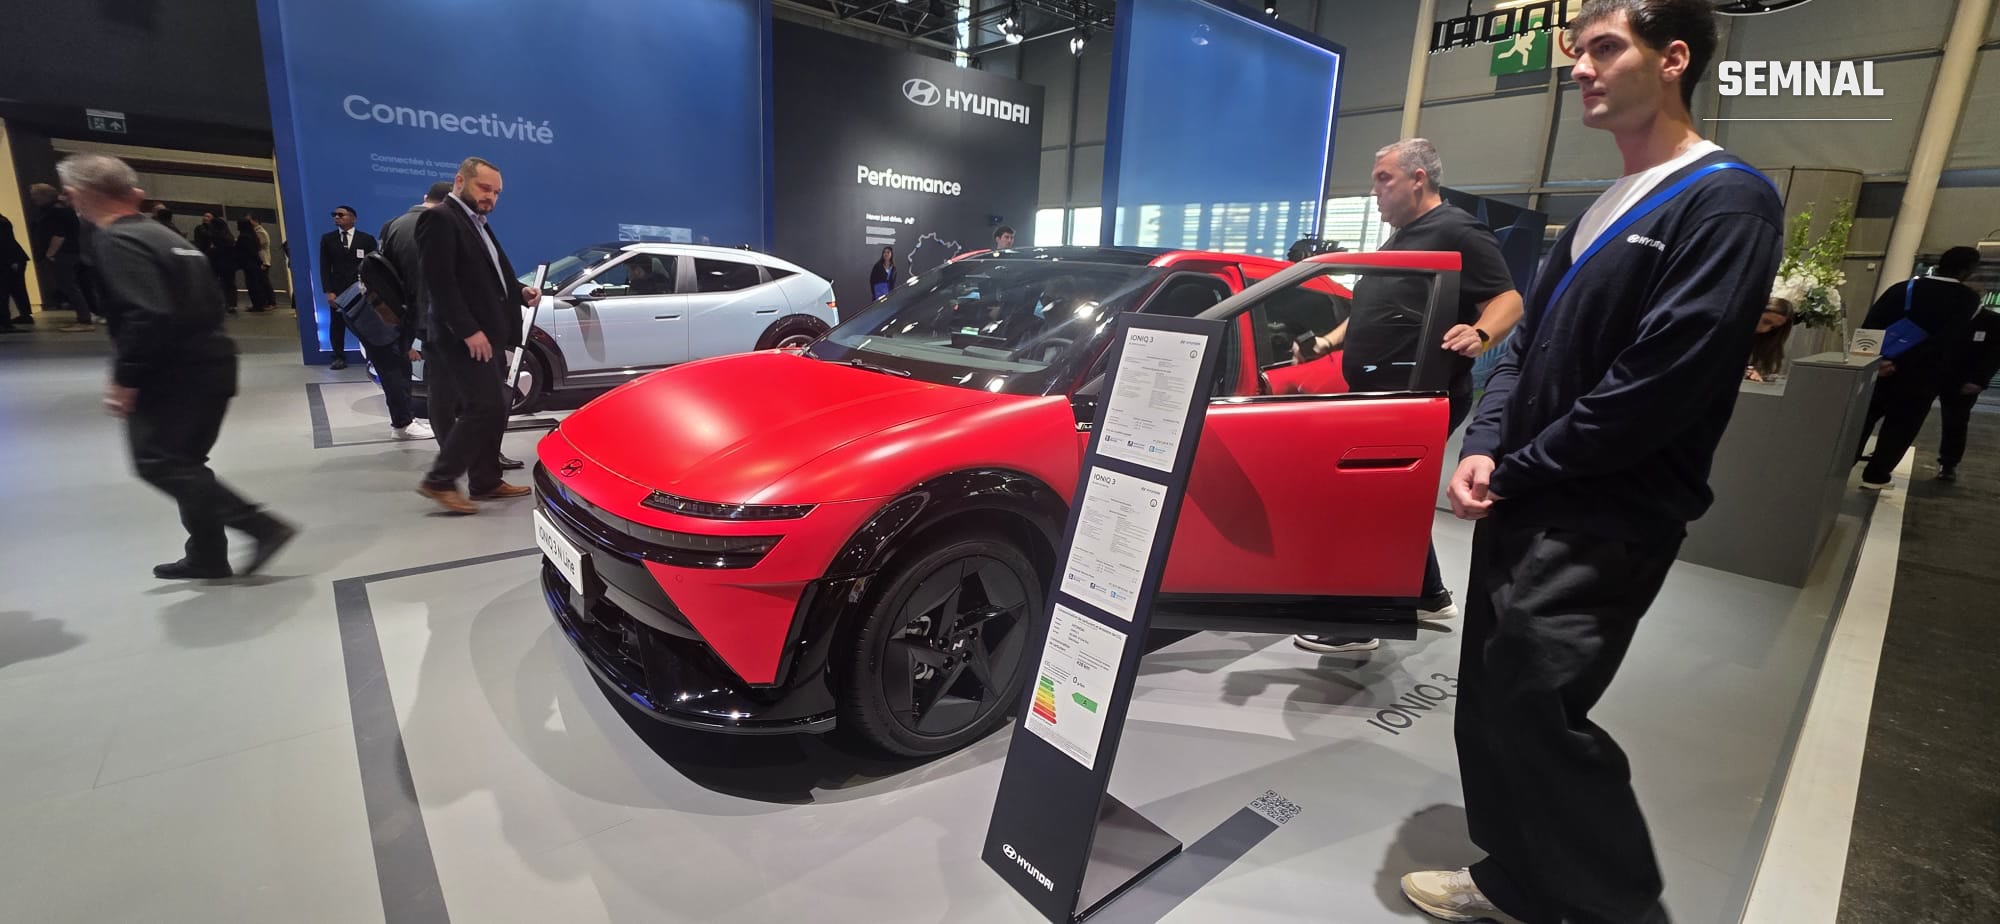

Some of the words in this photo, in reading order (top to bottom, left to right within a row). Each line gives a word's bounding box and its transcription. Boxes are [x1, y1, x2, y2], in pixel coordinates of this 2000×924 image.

[343, 94, 553, 144] Connectivité
[945, 88, 1030, 125] HYUNDAI
[371, 163, 426, 176] Connected
[427, 168, 438, 177] to
[857, 164, 961, 197] Performance
[1130, 334, 1148, 343] IONIQ
[1149, 336, 1154, 344] 3
[1093, 473, 1111, 484] IONIQ
[1366, 684, 1457, 735] IONIQ
[1431, 673, 1458, 688] 3
[1016, 854, 1054, 892] HYUNDAI
